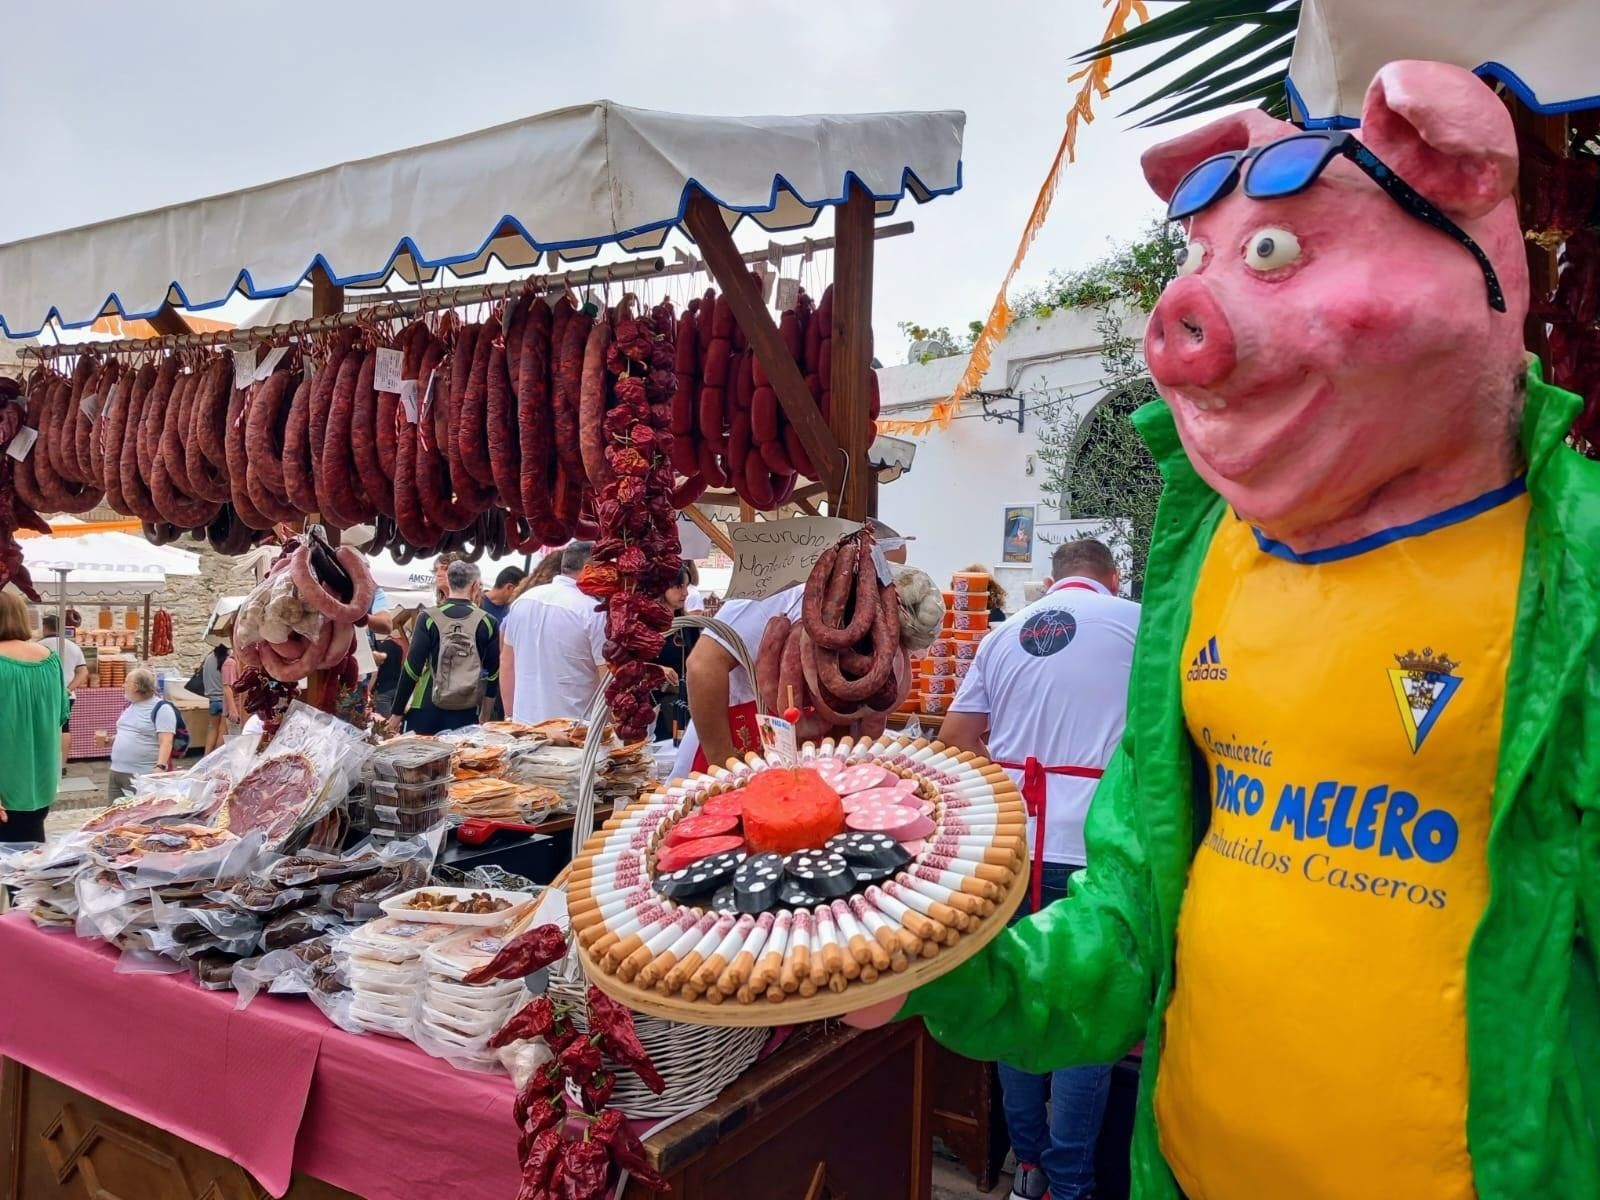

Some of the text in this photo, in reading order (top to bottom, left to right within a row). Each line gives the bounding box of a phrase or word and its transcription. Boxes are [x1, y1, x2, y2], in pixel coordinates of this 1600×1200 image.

[26, 559, 166, 574] campo
[408, 573, 435, 585] AMSTE
[1186, 664, 1228, 681] adidas
[1215, 763, 1460, 864] PACO MELERO
[1202, 828, 1448, 910] mbutidos Caseros
